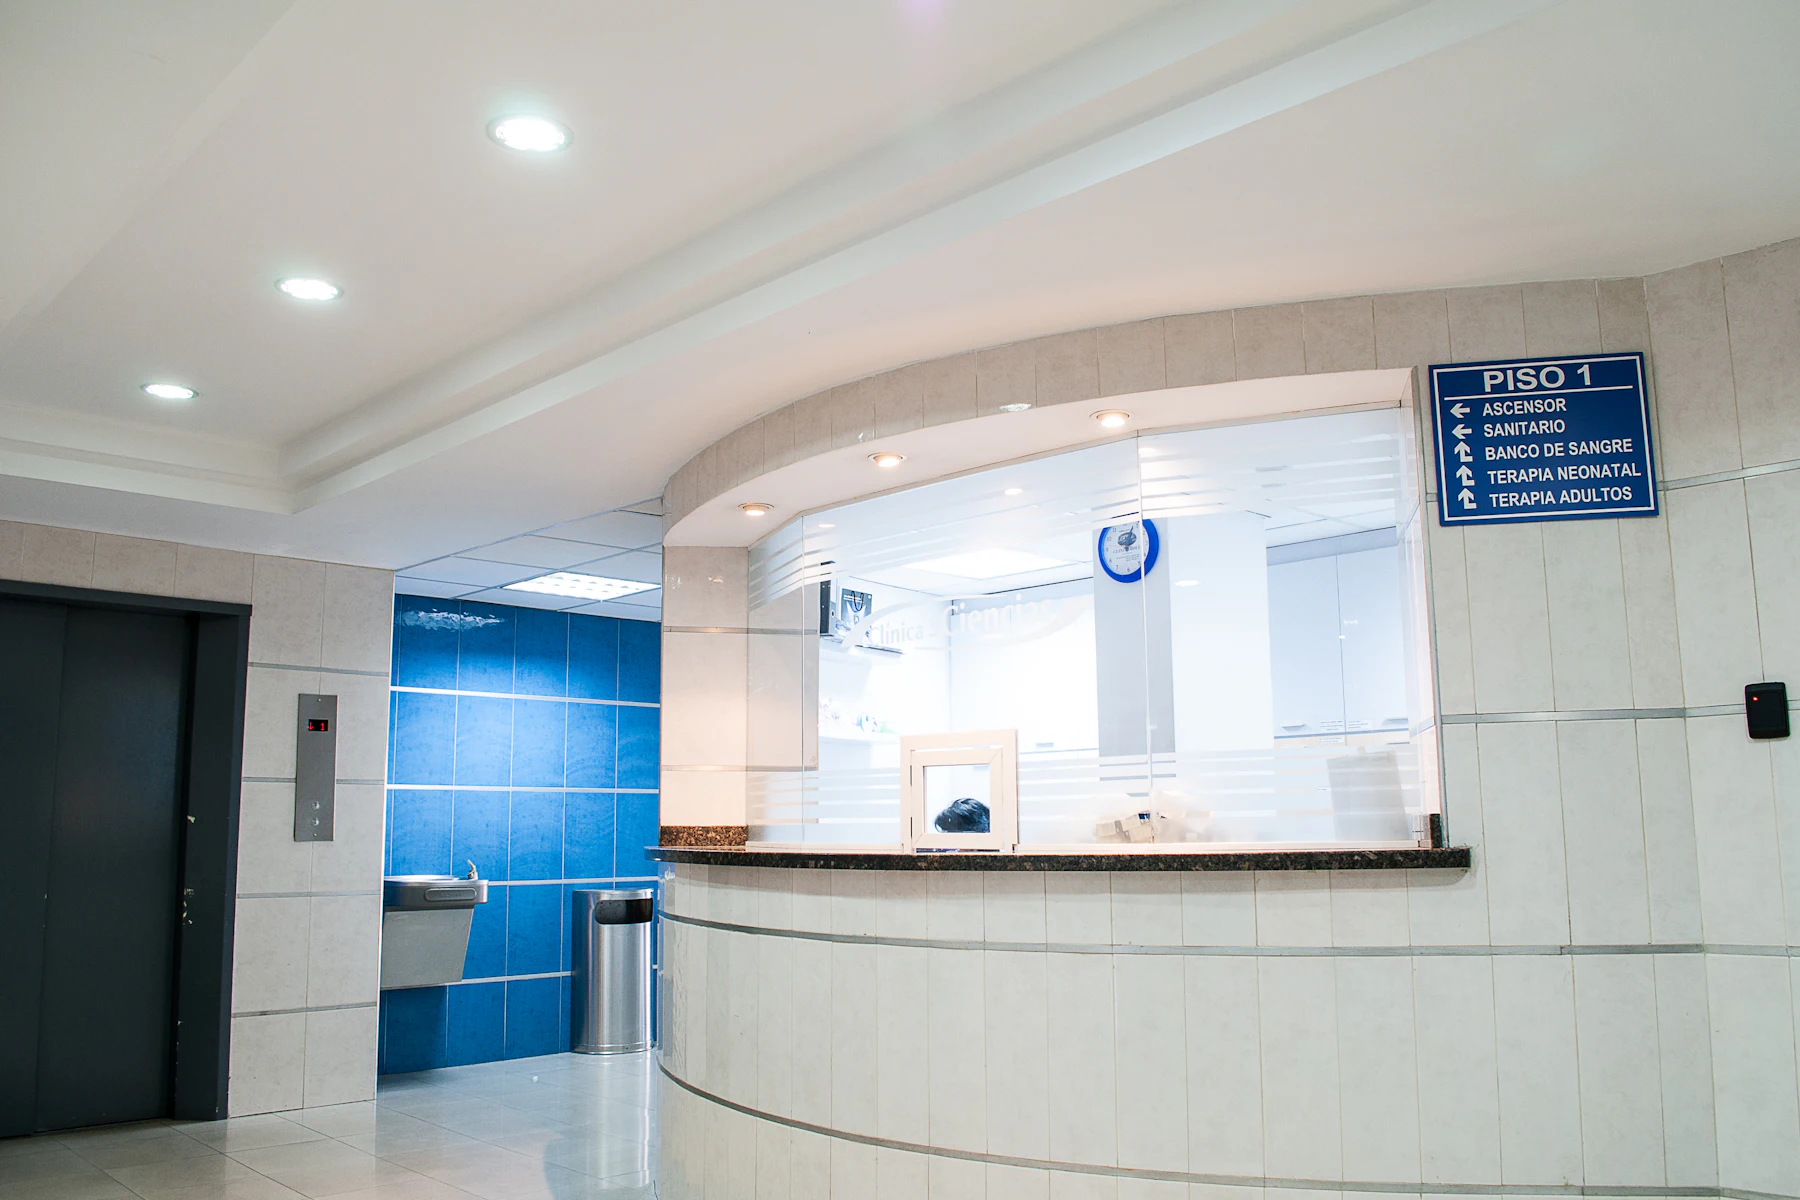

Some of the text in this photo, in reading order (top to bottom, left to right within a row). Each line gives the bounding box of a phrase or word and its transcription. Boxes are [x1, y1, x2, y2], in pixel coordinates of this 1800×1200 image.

[1483, 364, 1591, 392] PISO 1
[1482, 398, 1567, 416] ASCENSOR
[1484, 419, 1566, 437] SANITARIO
[1485, 438, 1633, 460] BANCO DE SANGRE
[1487, 462, 1642, 484] TERAPIA NEONATAL
[1489, 486, 1633, 507] TERAPIA ADULTOS
[869, 622, 924, 646] Clínica
[320, 722, 325, 731] 1
